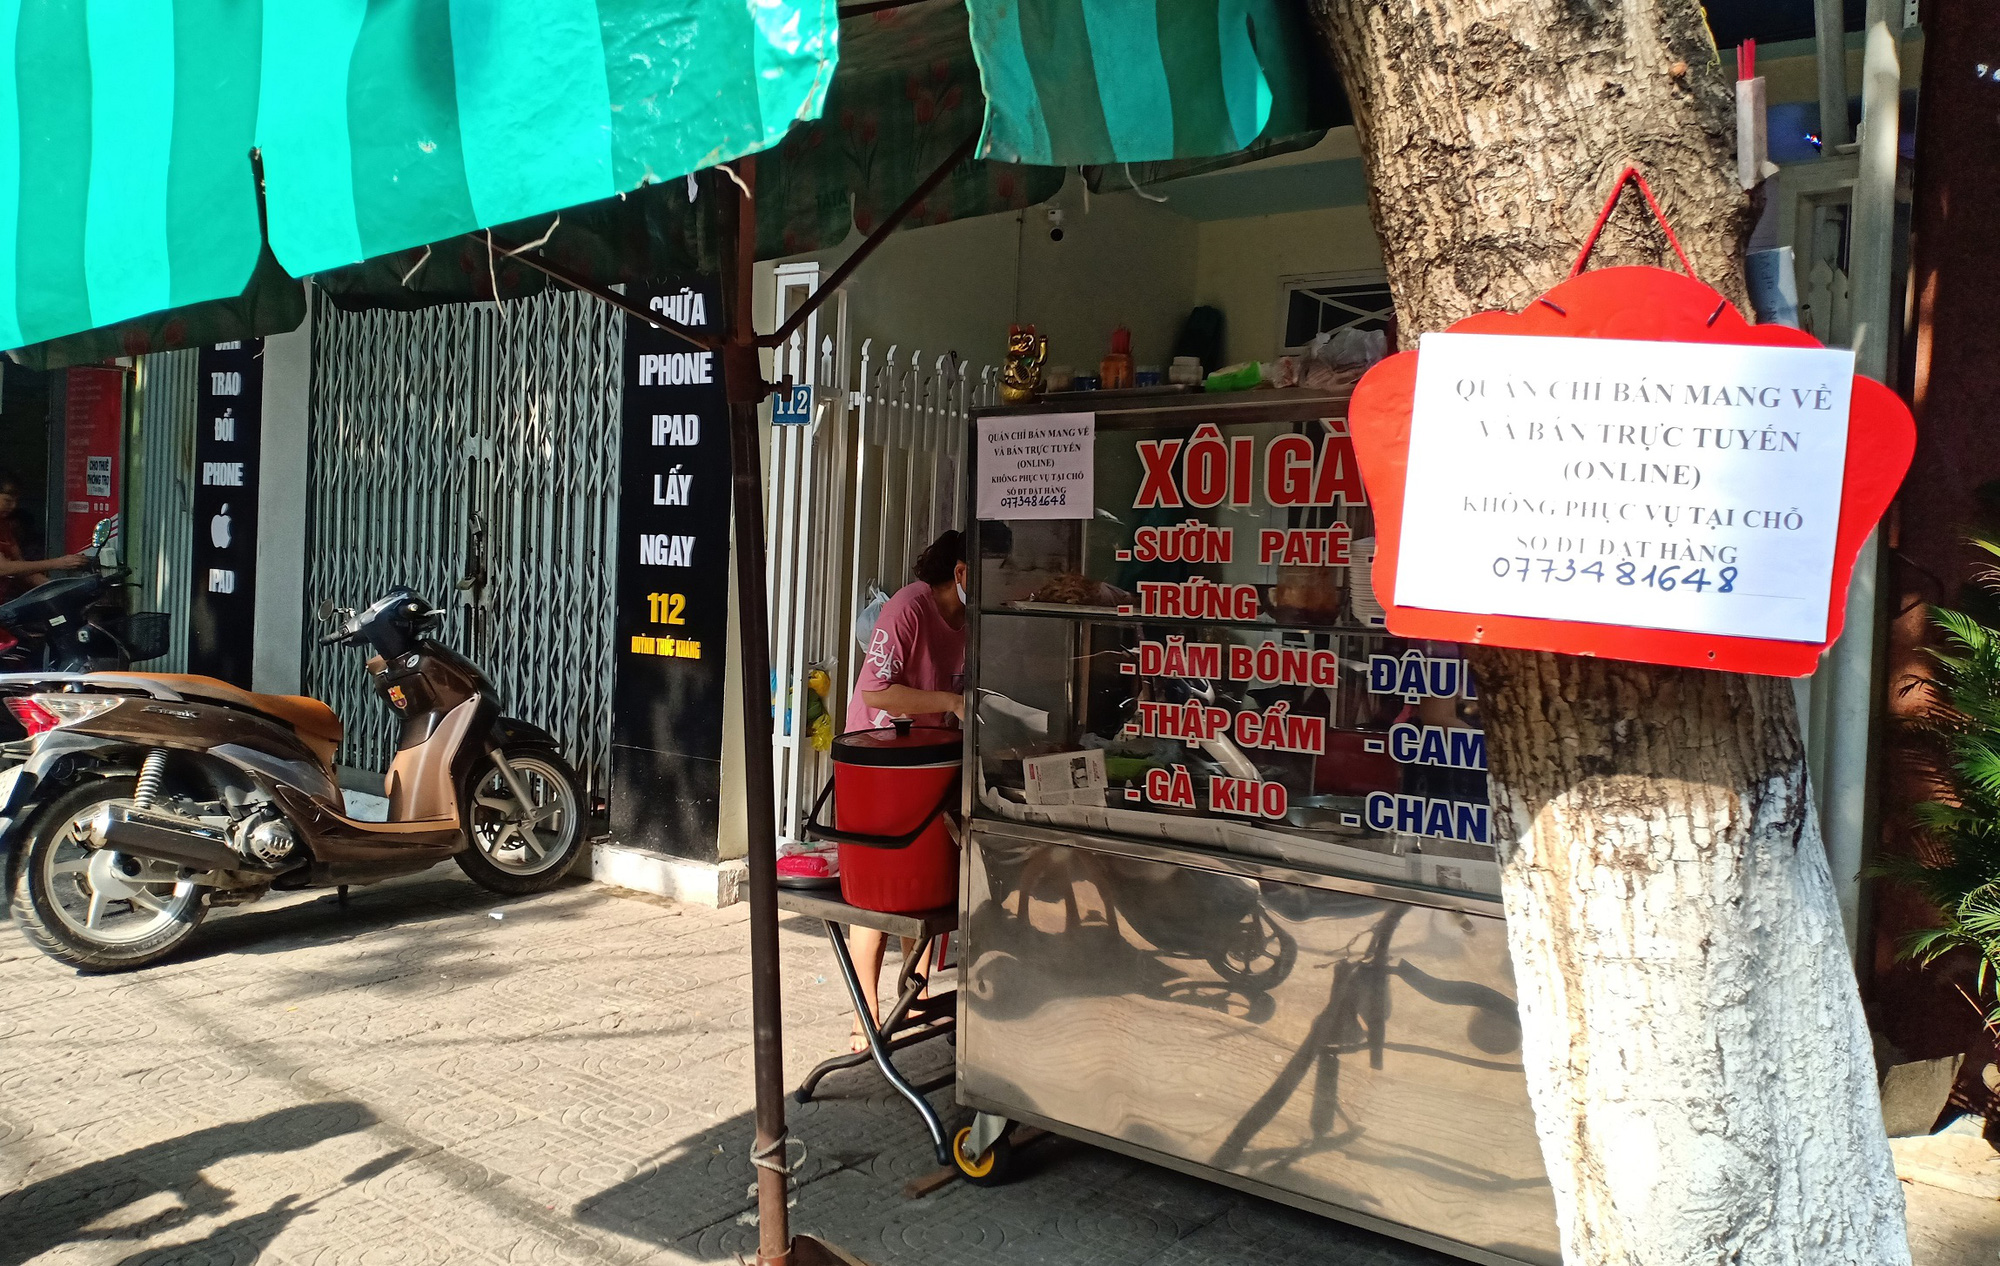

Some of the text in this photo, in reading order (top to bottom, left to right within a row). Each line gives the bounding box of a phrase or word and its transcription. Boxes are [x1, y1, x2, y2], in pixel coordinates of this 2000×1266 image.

[211, 372, 241, 396] TRAO
[639, 351, 714, 386] IPHONE
[777, 390, 808, 415] 112
[1613, 376, 1674, 404] BÁN
[1684, 383, 1781, 409] MANG
[1790, 382, 1833, 411] VỀ
[214, 408, 235, 441] ĐỔI
[652, 414, 700, 446] IPAD
[988, 432, 1009, 443] QUÁN
[1028, 428, 1045, 439] BÁN
[1048, 428, 1076, 438] MANG
[1528, 416, 1586, 442] BÁN
[1598, 422, 1684, 452] TRỰC
[1693, 423, 1801, 454] TUYẾN
[994, 441, 1081, 456] VÀ BÁN TRỰC TUYẾN
[1017, 459, 1055, 469] (ONLINE)
[1132, 417, 1367, 508] XÔI GÀ
[202, 462, 244, 486] IPHONE
[653, 464, 694, 506] LẤY
[991, 474, 1018, 484] KHÔNG
[1019, 474, 1037, 483] PHỤC
[1039, 474, 1051, 482] VỤ
[1052, 473, 1065, 482] TẠI
[1564, 460, 1701, 490] (ONLINE)
[1000, 494, 1066, 508] 0773481648
[1006, 487, 1016, 496] SỐ
[1044, 486, 1066, 494] HÀNG
[1463, 491, 1805, 531] KHÔNG PHỤC VỤ TẠI CHỖ
[640, 534, 696, 567] NGAY
[1258, 521, 1353, 567] PATÊ
[1660, 537, 1738, 565] HÀNG
[208, 568, 235, 594] IPAD
[647, 592, 686, 625] 112
[1229, 640, 1339, 689] BÔNG
[1367, 649, 1460, 705] ĐẬU
[1234, 701, 1326, 755] CẨM
[1209, 775, 1287, 820] KHO
